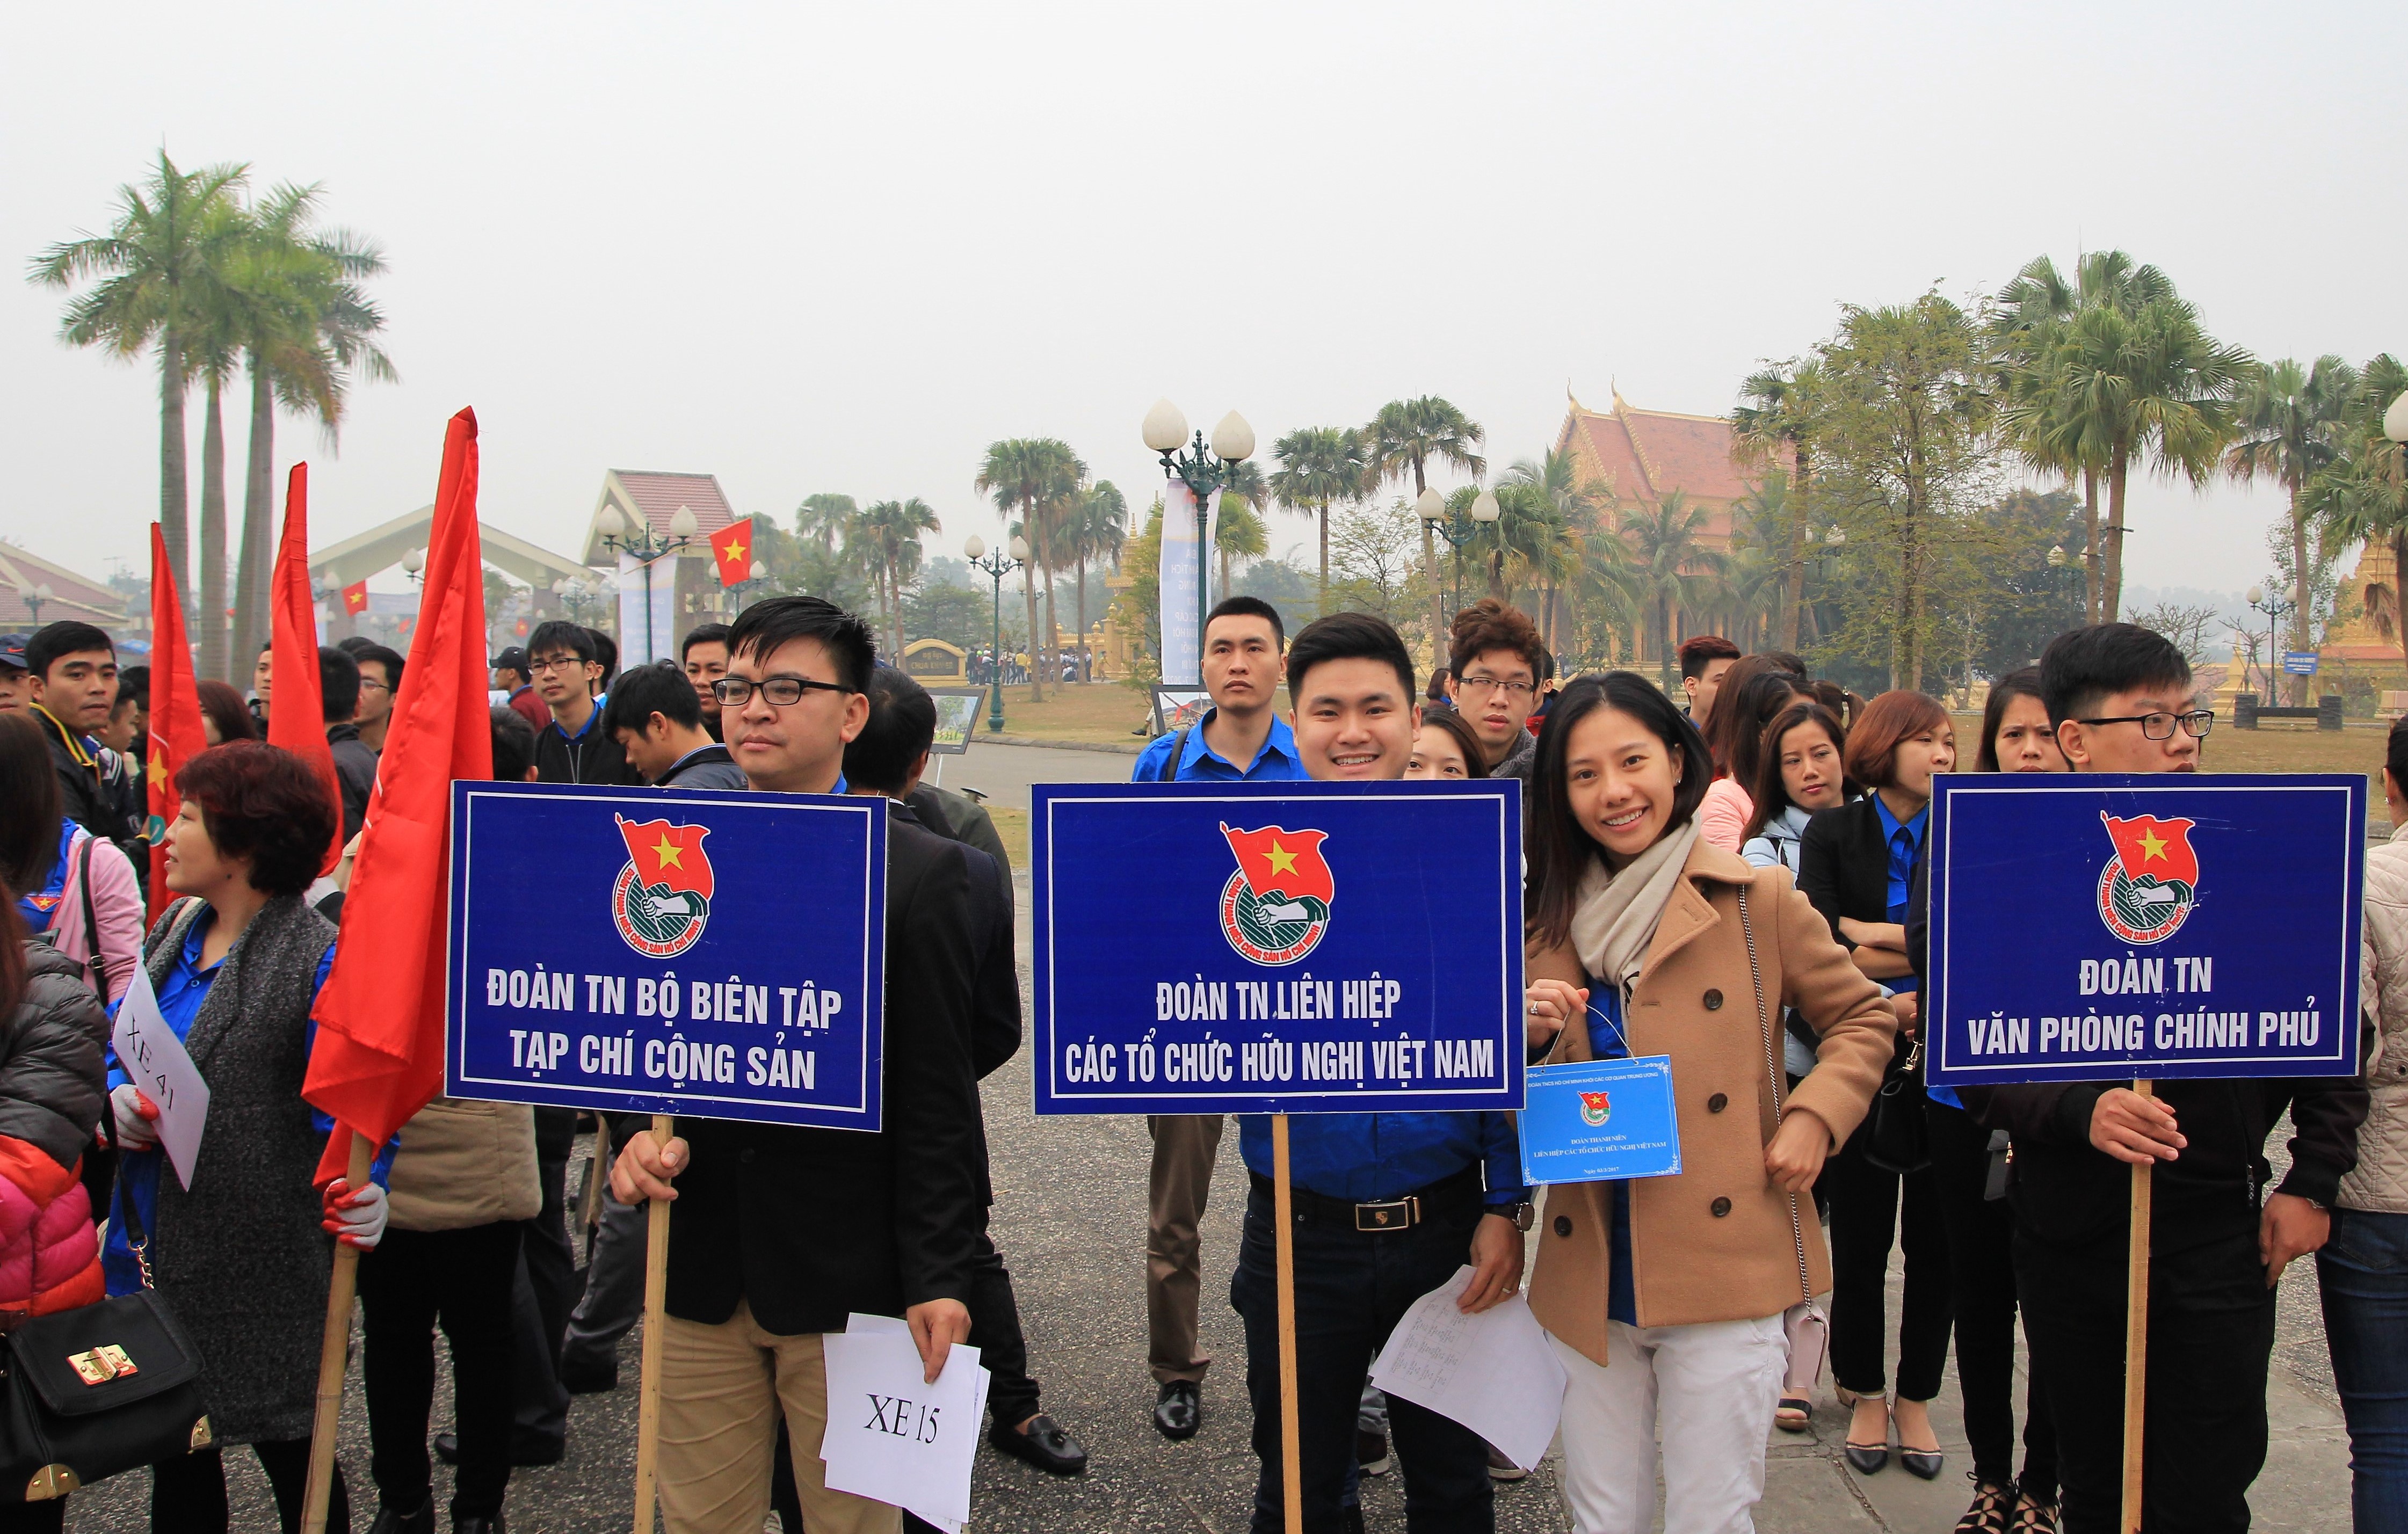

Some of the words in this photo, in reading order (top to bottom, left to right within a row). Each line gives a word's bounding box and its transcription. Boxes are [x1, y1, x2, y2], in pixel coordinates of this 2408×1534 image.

[487, 963, 574, 1010] ĐOÀN
[585, 975, 625, 1014] TN
[637, 971, 679, 1027] BỘ
[692, 976, 767, 1024] BIÊN
[779, 980, 842, 1037] TẬP
[1156, 973, 1227, 1021] ĐOÀN
[1236, 982, 1268, 1020] TN
[1278, 972, 1333, 1019] LIÊN
[1343, 972, 1400, 1027] HIỆP
[2079, 951, 2163, 995] ĐOÀN
[2174, 957, 2211, 992] TN
[1968, 1011, 2029, 1055] VĂN
[2040, 1007, 2144, 1052] PHÒNG
[2155, 1006, 2248, 1049] CHÍNH
[2259, 996, 2319, 1046] PHỦ
[127, 1013, 153, 1074] XE
[156, 1074, 174, 1111] 41
[510, 1030, 568, 1077] TẠP
[580, 1030, 634, 1075] CHÍ
[645, 1033, 734, 1088] CỘNG
[747, 1031, 814, 1089] SẢN
[1066, 1036, 1116, 1082] CÁC
[1125, 1028, 1156, 1082] TỔ
[1165, 1032, 1232, 1082] CHỨC
[1242, 1033, 1292, 1081] HỮU
[1302, 1042, 1363, 1088] NGHỊ
[1372, 1033, 1425, 1087] VIỆT
[1435, 1038, 1494, 1079] NAM
[1590, 1135, 1611, 1143] THANH
[864, 1393, 912, 1437] XE
[915, 1404, 941, 1444] 15
